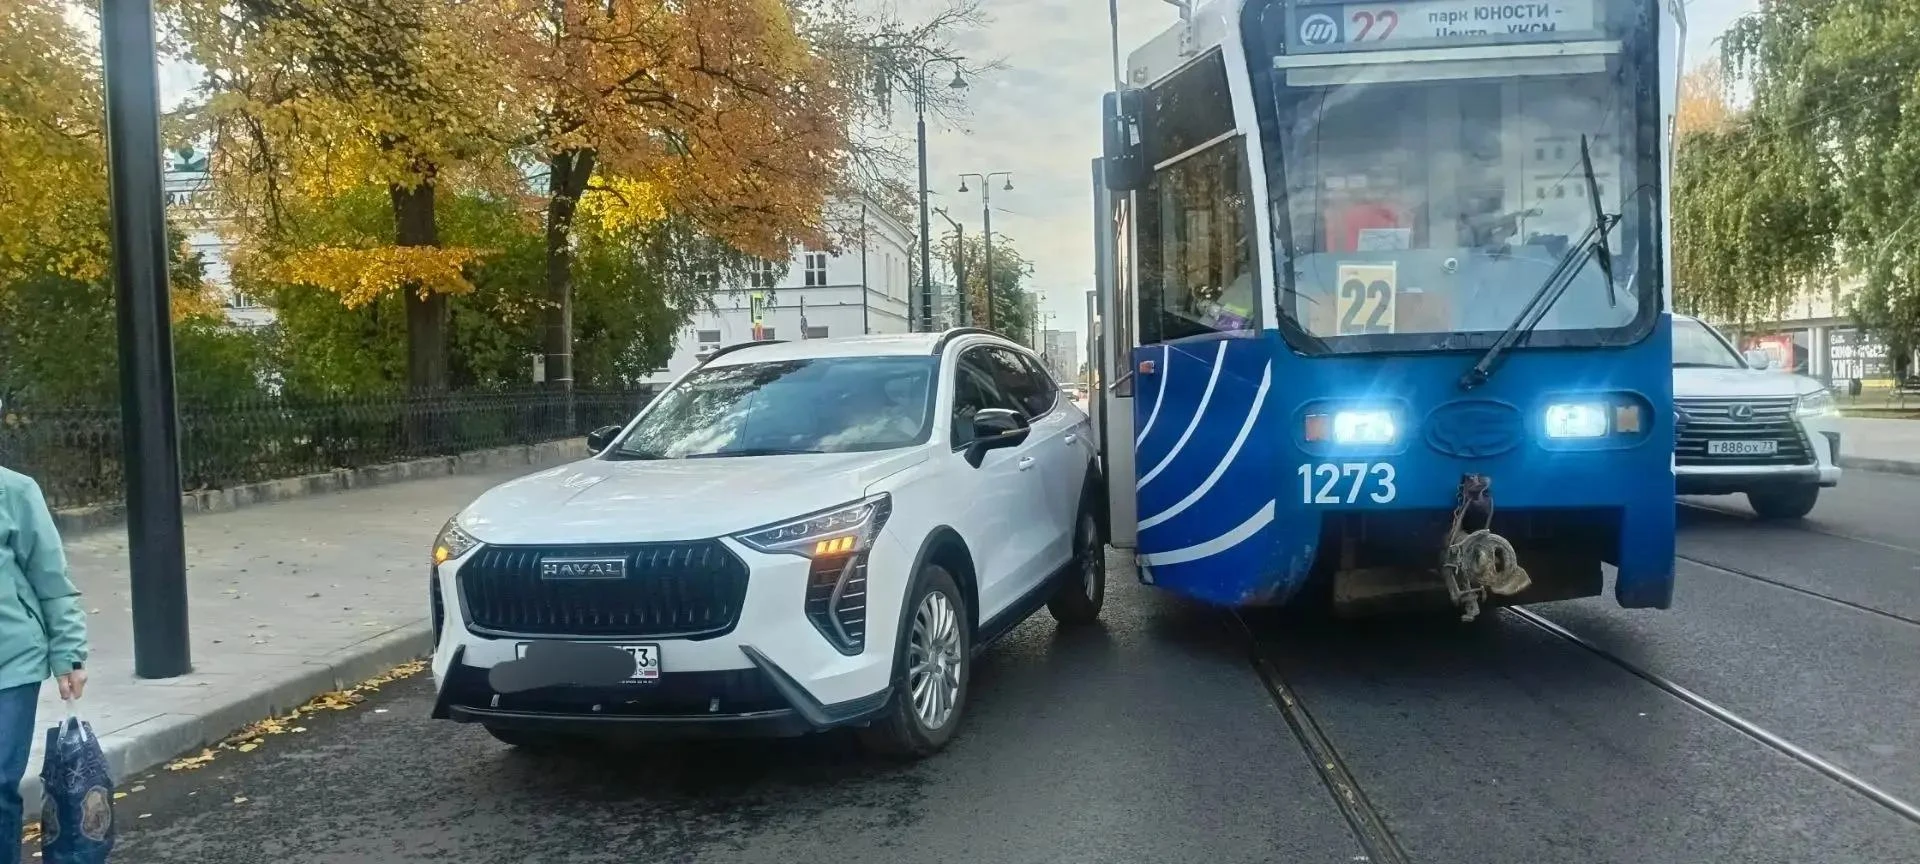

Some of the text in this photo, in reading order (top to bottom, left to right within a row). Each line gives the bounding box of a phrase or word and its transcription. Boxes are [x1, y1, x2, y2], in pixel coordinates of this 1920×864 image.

[1352, 10, 1398, 42] 22
[1428, 9, 1468, 25] парк
[1474, 3, 1549, 20] ЮНОСТИ
[1340, 278, 1391, 334] 22
[1298, 462, 1396, 504] 1273
[543, 563, 620, 576] HAVAL
